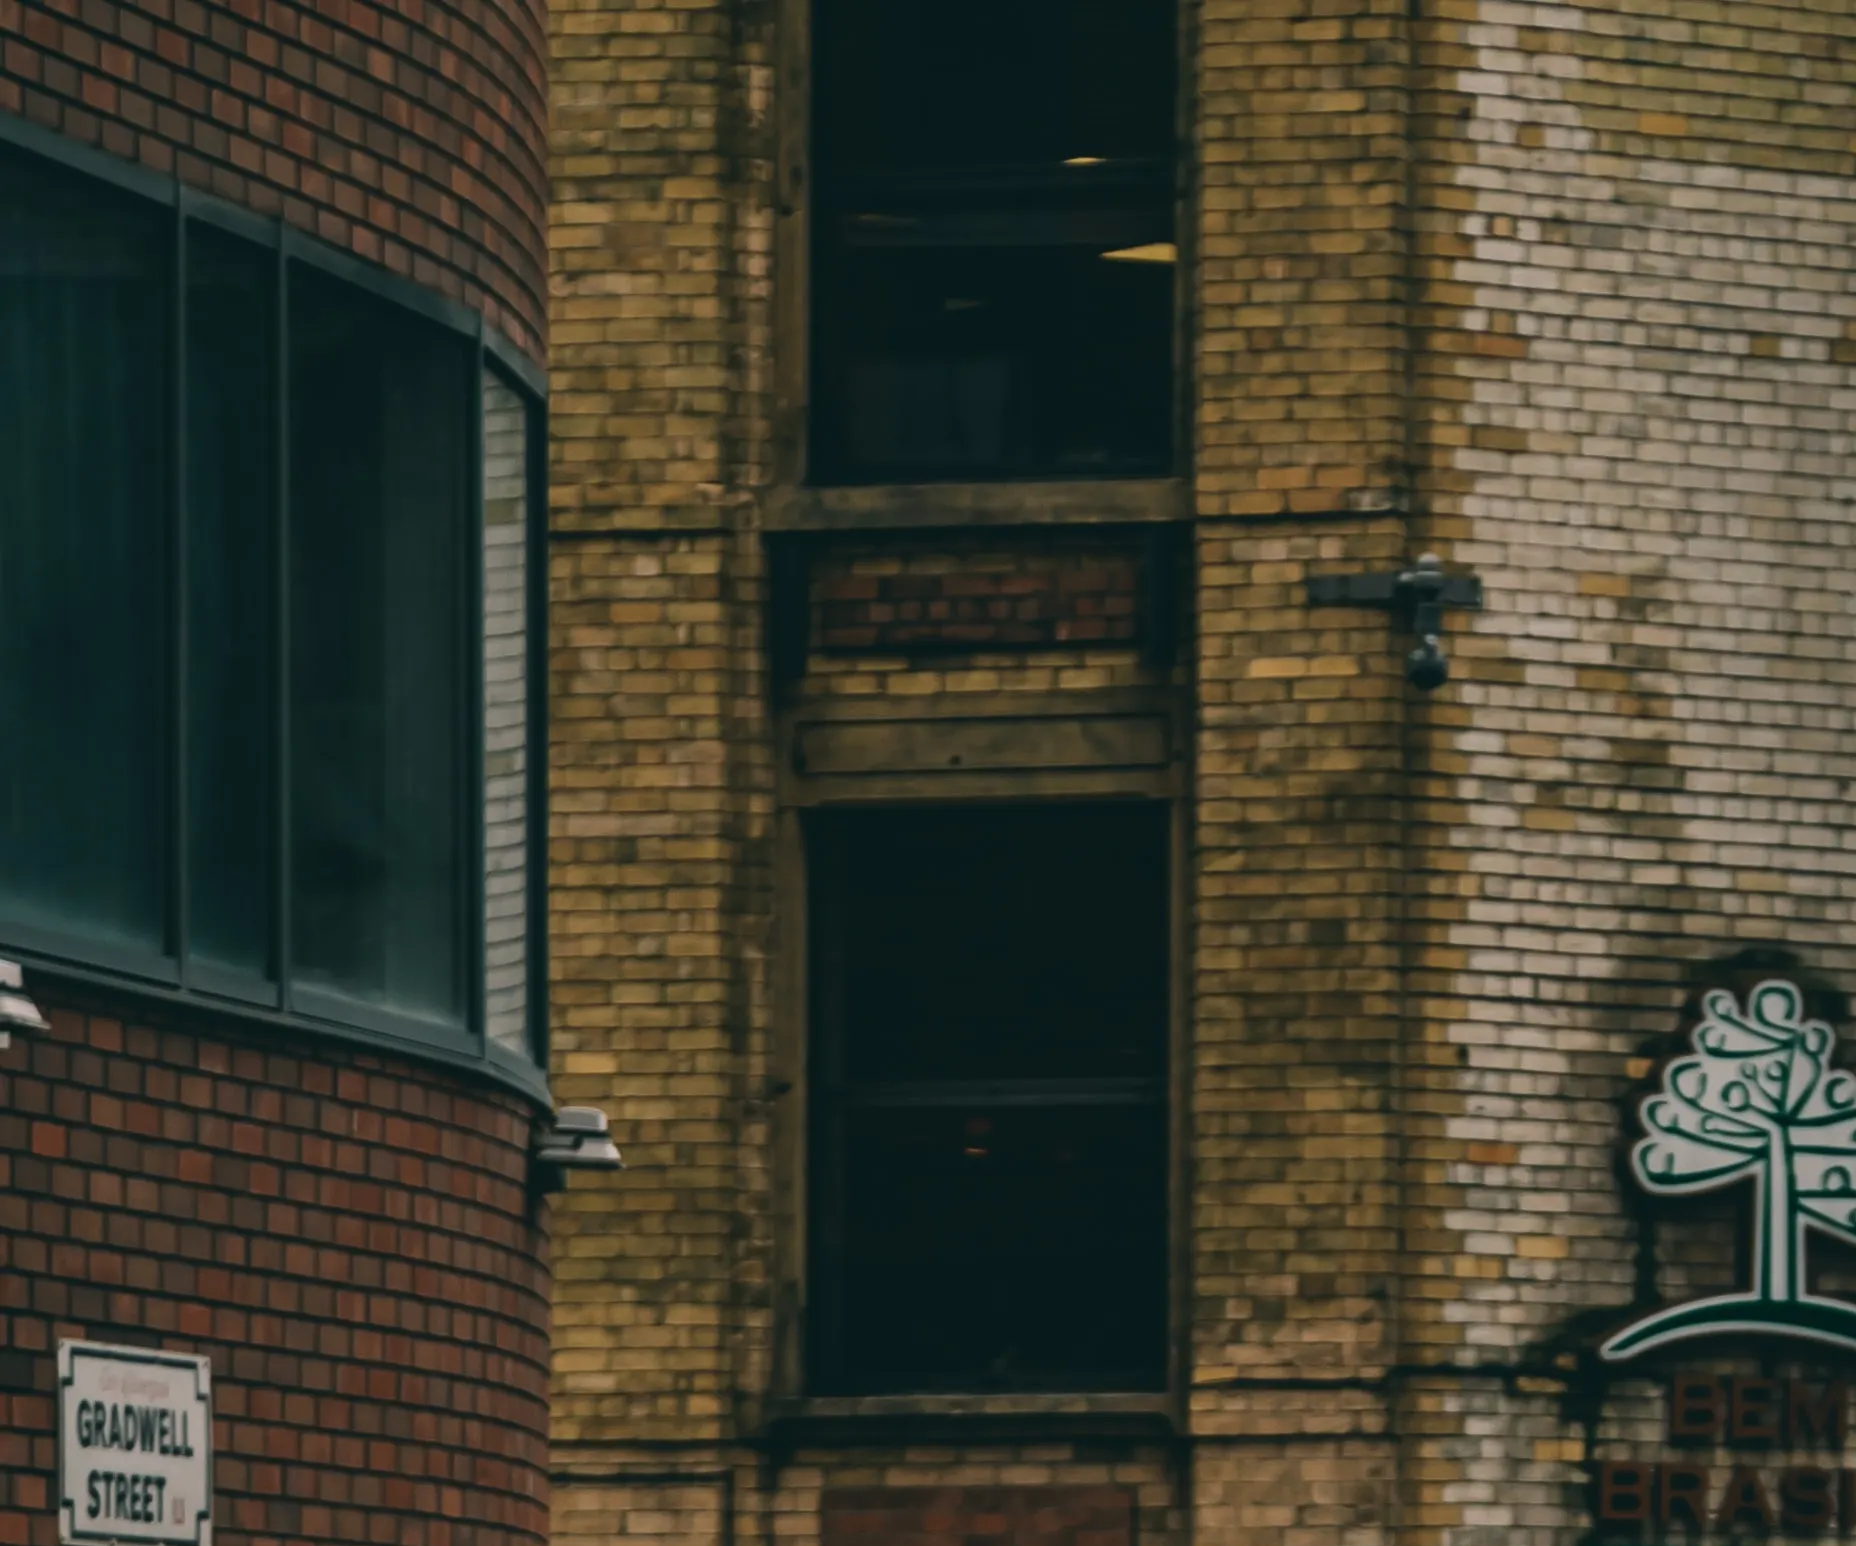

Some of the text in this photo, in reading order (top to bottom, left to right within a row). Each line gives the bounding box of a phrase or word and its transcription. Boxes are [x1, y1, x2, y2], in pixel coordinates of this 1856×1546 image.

[77, 1398, 194, 1457] GRADWELL
[1671, 1371, 1848, 1446] BEM
[87, 1469, 167, 1523] STREET
